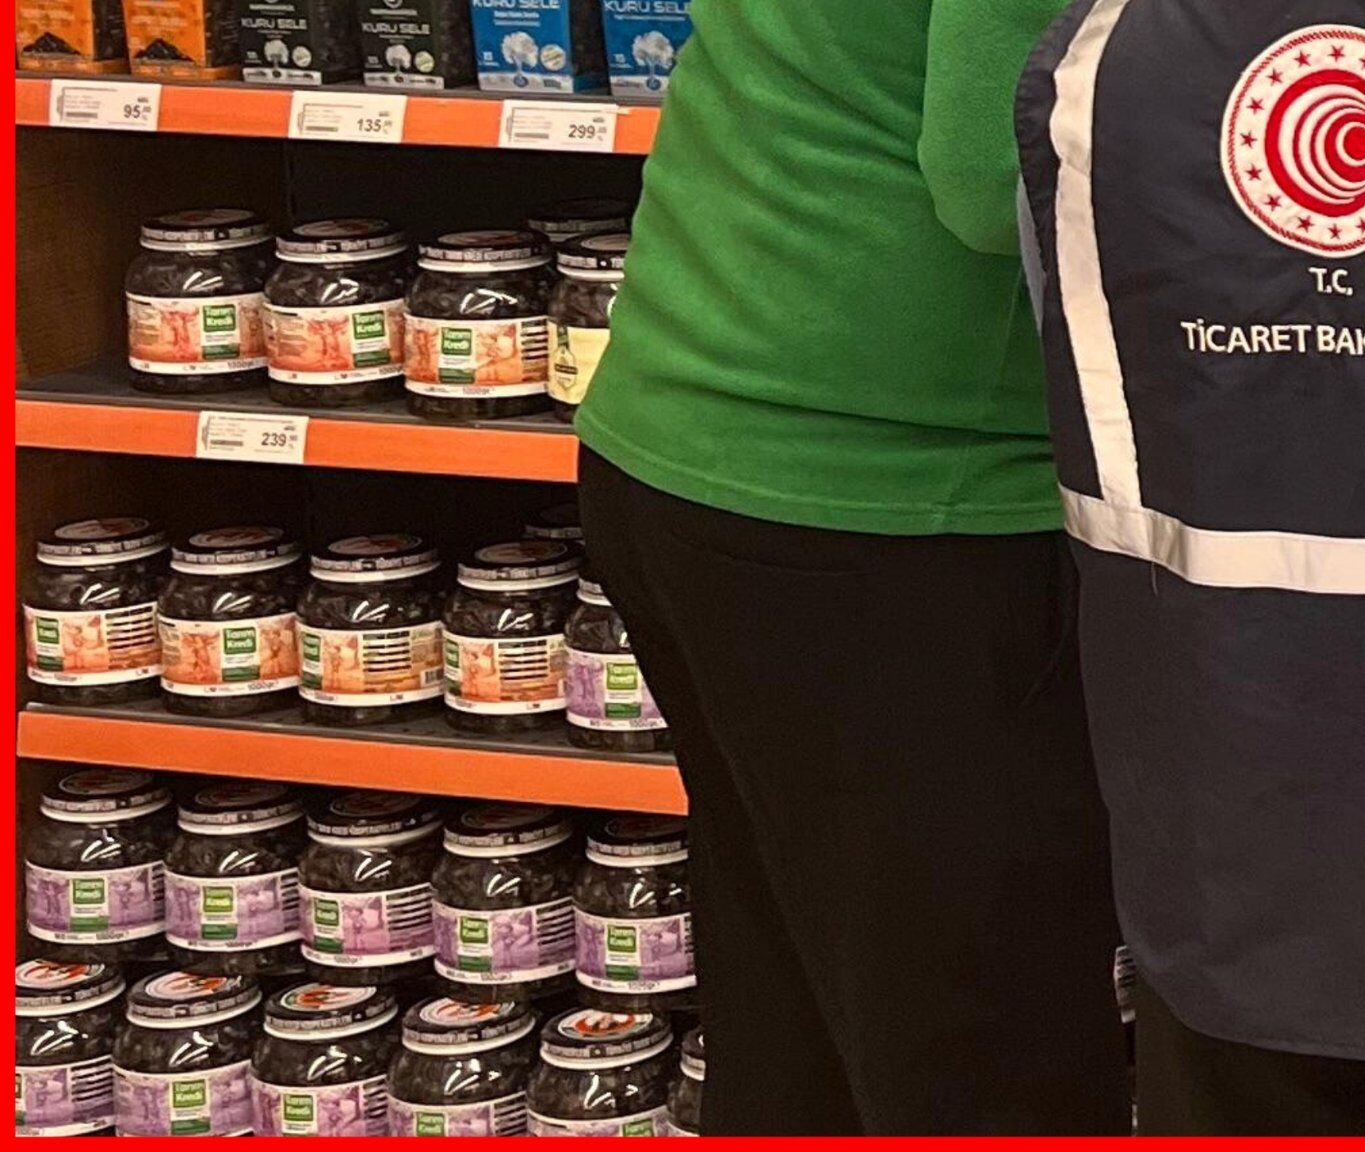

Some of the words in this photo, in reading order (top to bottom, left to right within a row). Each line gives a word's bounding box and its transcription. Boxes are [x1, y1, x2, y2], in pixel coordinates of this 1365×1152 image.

[604, 0, 650, 13] KURU
[1309, 267, 1353, 296] T.C.
[1181, 319, 1307, 354] TİCARET
[261, 432, 287, 447] 239
